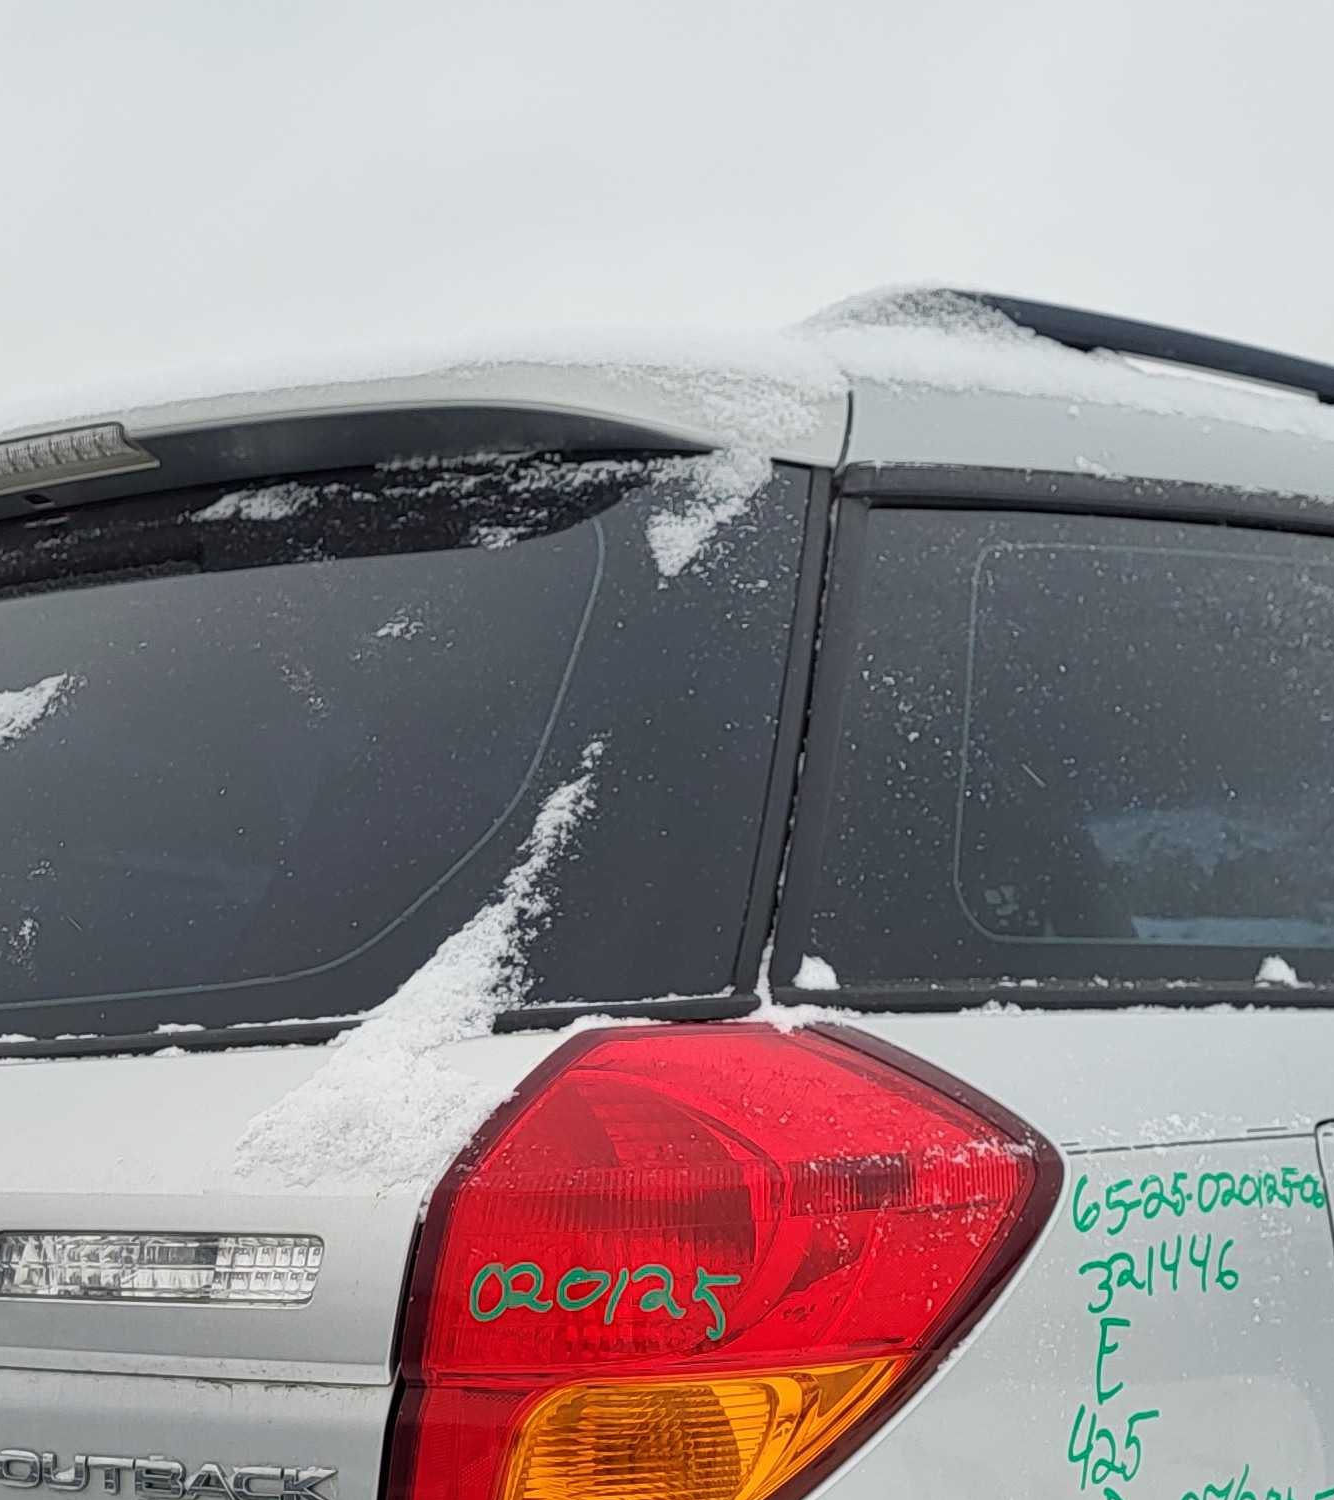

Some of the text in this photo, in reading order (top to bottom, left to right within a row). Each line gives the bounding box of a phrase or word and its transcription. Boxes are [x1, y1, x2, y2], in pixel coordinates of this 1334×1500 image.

[470, 1262, 742, 1341] 020125
[1078, 1234, 1240, 1314] 321446
[1096, 1318, 1132, 1404] E
[1067, 1403, 1160, 1491] 425
